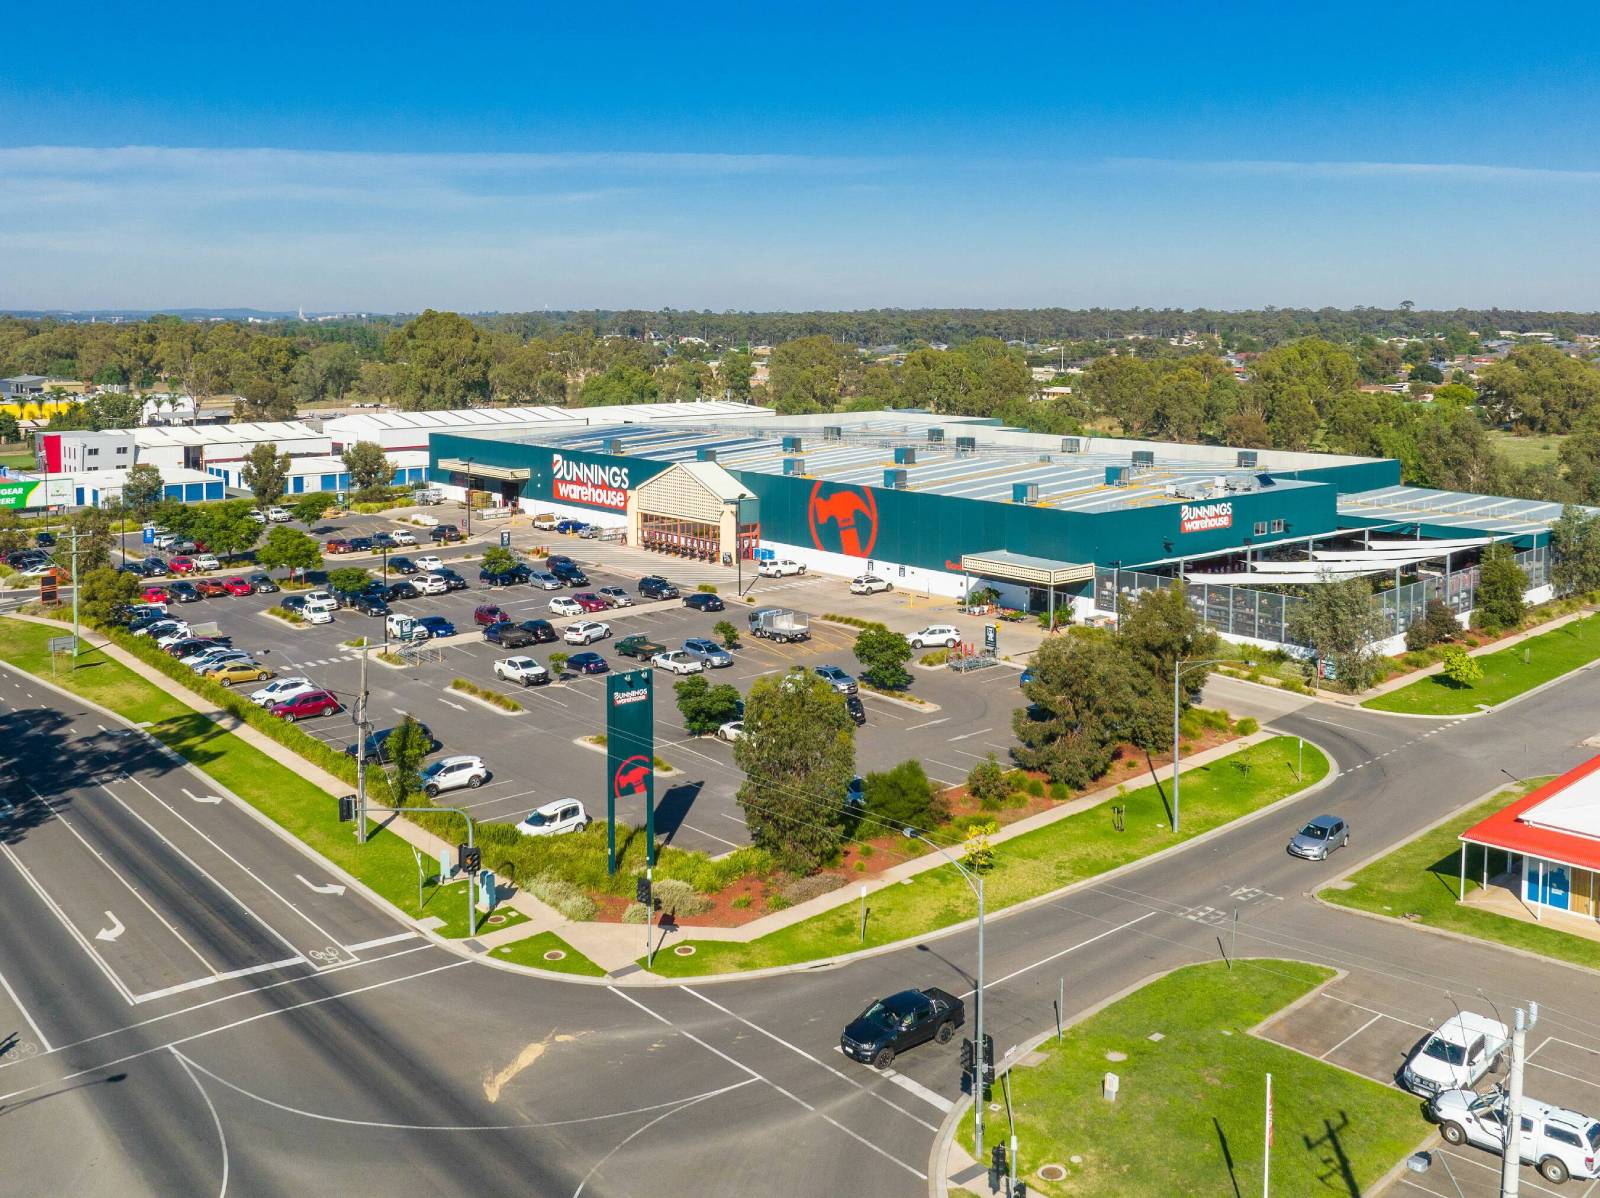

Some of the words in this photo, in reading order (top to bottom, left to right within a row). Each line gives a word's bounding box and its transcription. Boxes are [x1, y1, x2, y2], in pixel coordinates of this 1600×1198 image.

[552, 454, 629, 489] BUNNINGS
[0, 497, 16, 505] ERE
[558, 480, 625, 507] warehouse
[1181, 503, 1232, 521] BUNNINGS
[1184, 516, 1229, 530] warehouse
[613, 688, 648, 700] BUNNINGS
